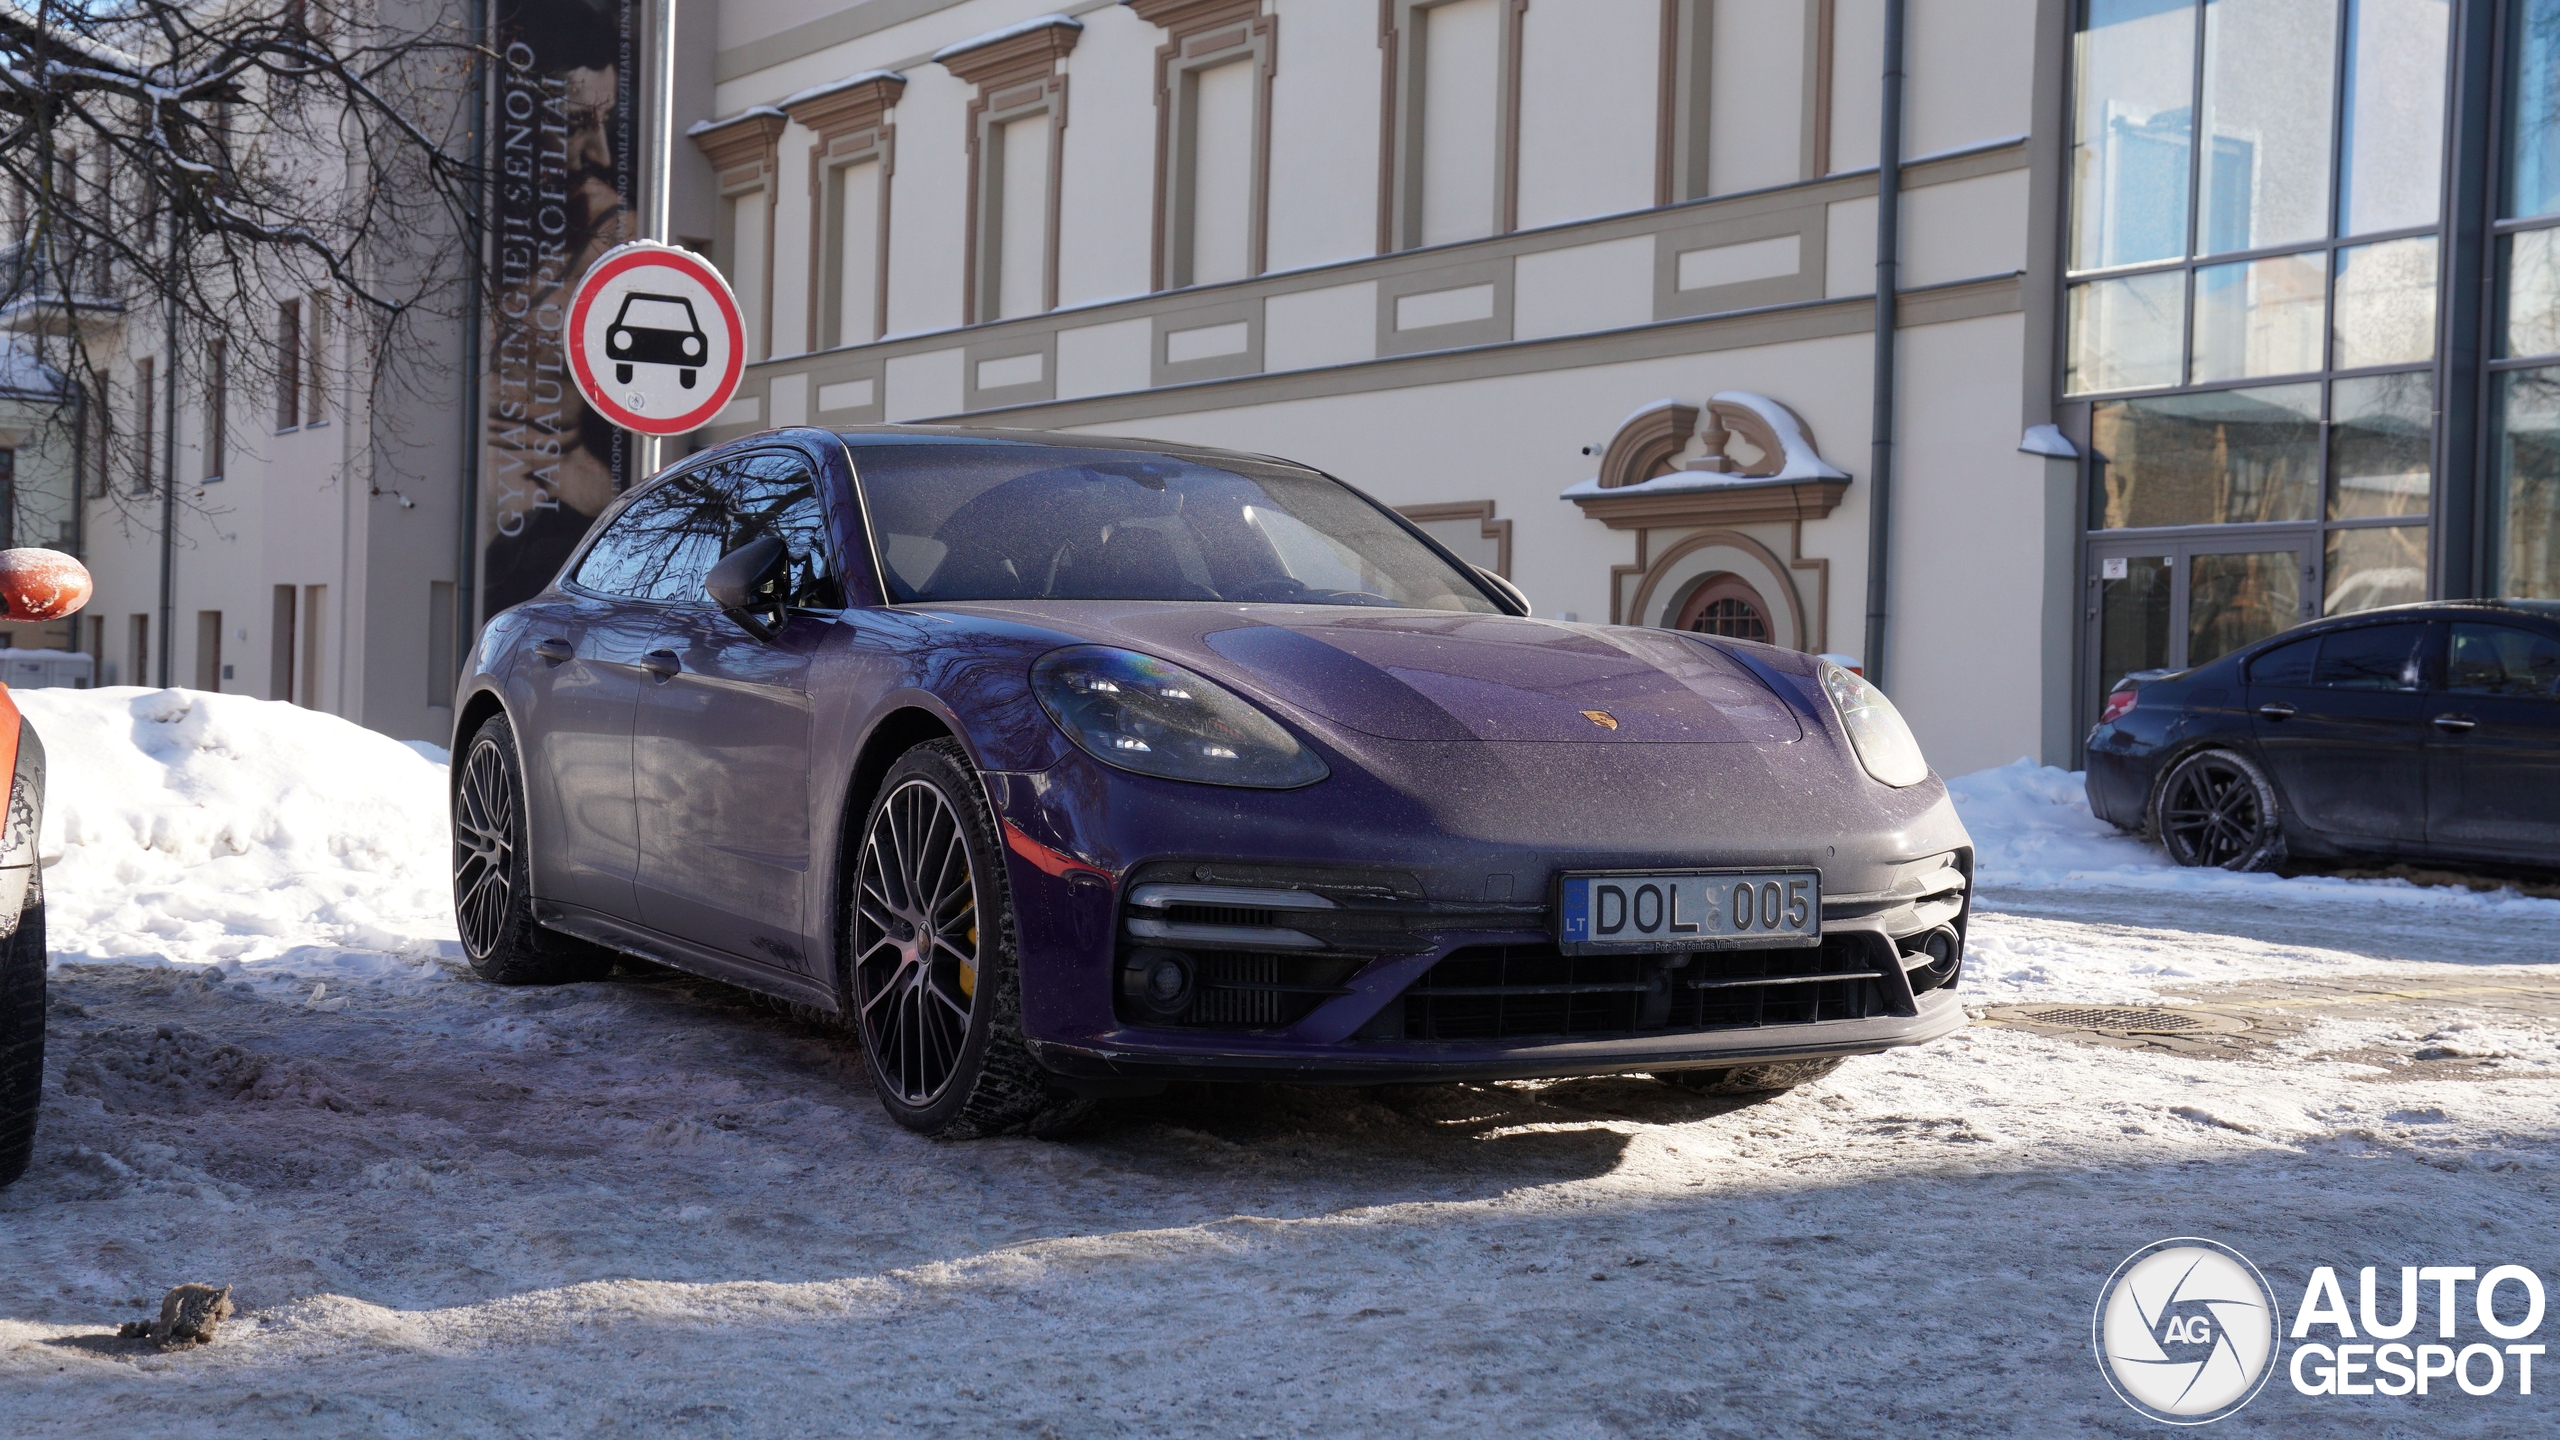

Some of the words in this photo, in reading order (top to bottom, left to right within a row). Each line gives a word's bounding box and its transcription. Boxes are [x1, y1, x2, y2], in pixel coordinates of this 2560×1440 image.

[618, 42, 632, 117] MUZIEJAUS
[504, 42, 536, 202] SENOJO
[537, 75, 568, 289] PROFILIAI
[617, 174, 628, 243] ONALINIO
[497, 215, 537, 537] GYVASTINGIEJI
[533, 303, 564, 512] PASAULIO
[611, 426, 622, 492] EUROPOS
[945, 771, 985, 856] MICHELIN
[1566, 918, 1586, 932] LT
[1597, 883, 1699, 935] DOL
[1733, 880, 1809, 931] 005
[1655, 942, 1686, 952] Porsche
[1687, 941, 1715, 951] centras
[1716, 939, 1741, 949] Vilnius
